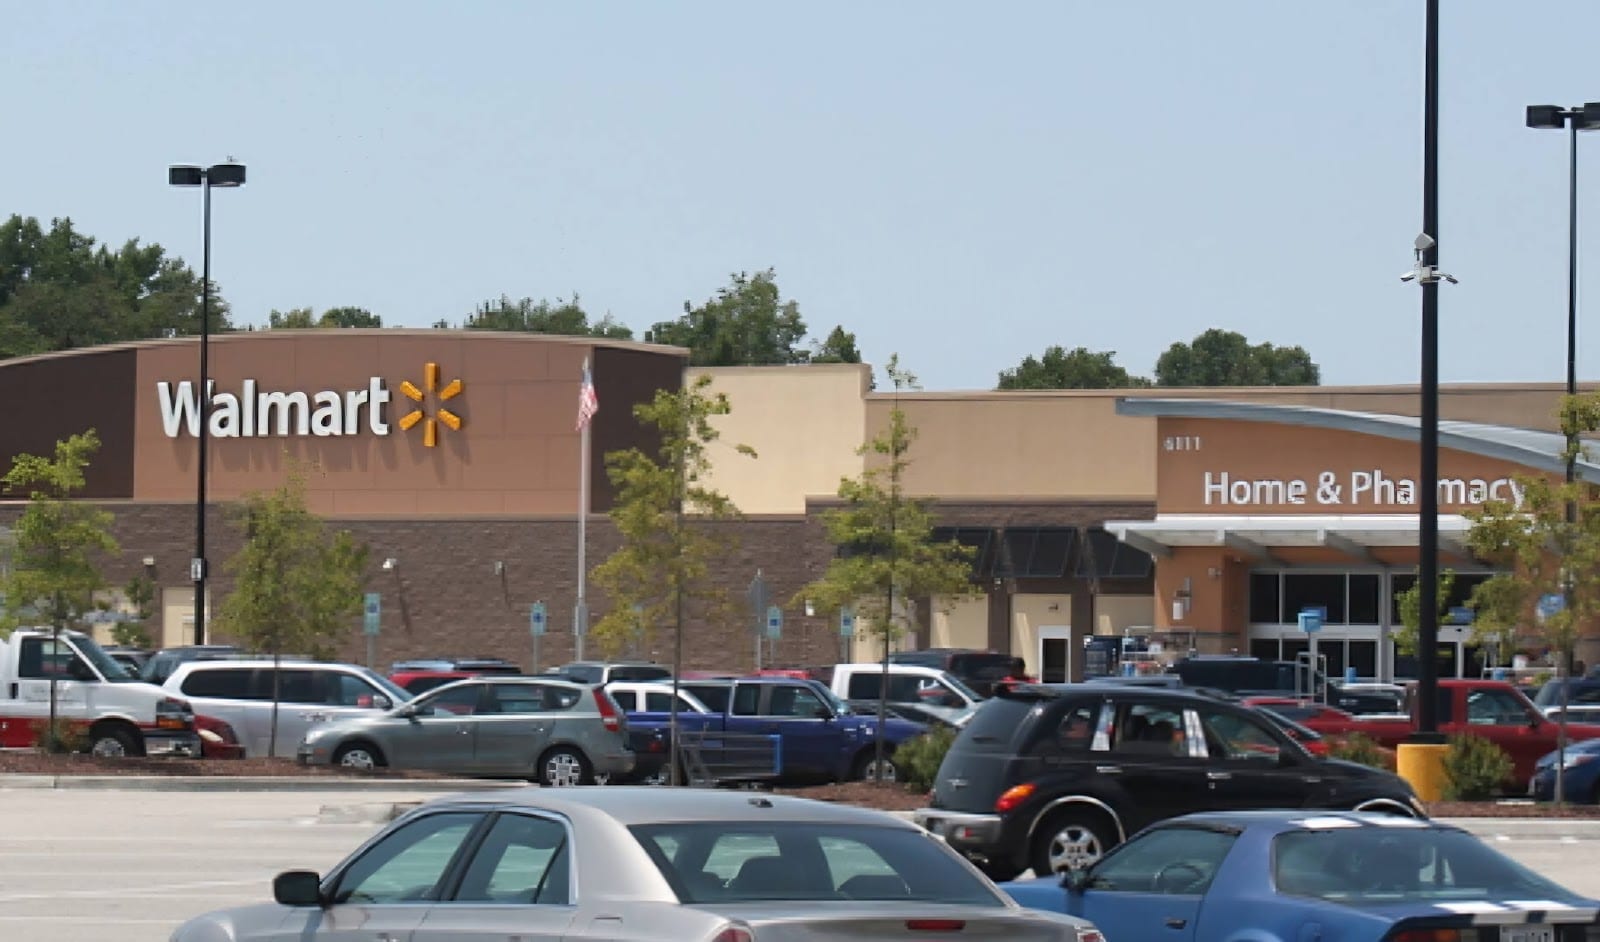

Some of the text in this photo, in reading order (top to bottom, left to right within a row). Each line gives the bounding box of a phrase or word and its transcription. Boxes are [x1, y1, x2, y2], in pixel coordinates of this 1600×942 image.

[156, 376, 390, 438] Walmart
[1204, 469, 1527, 512] Home & Phamacy
